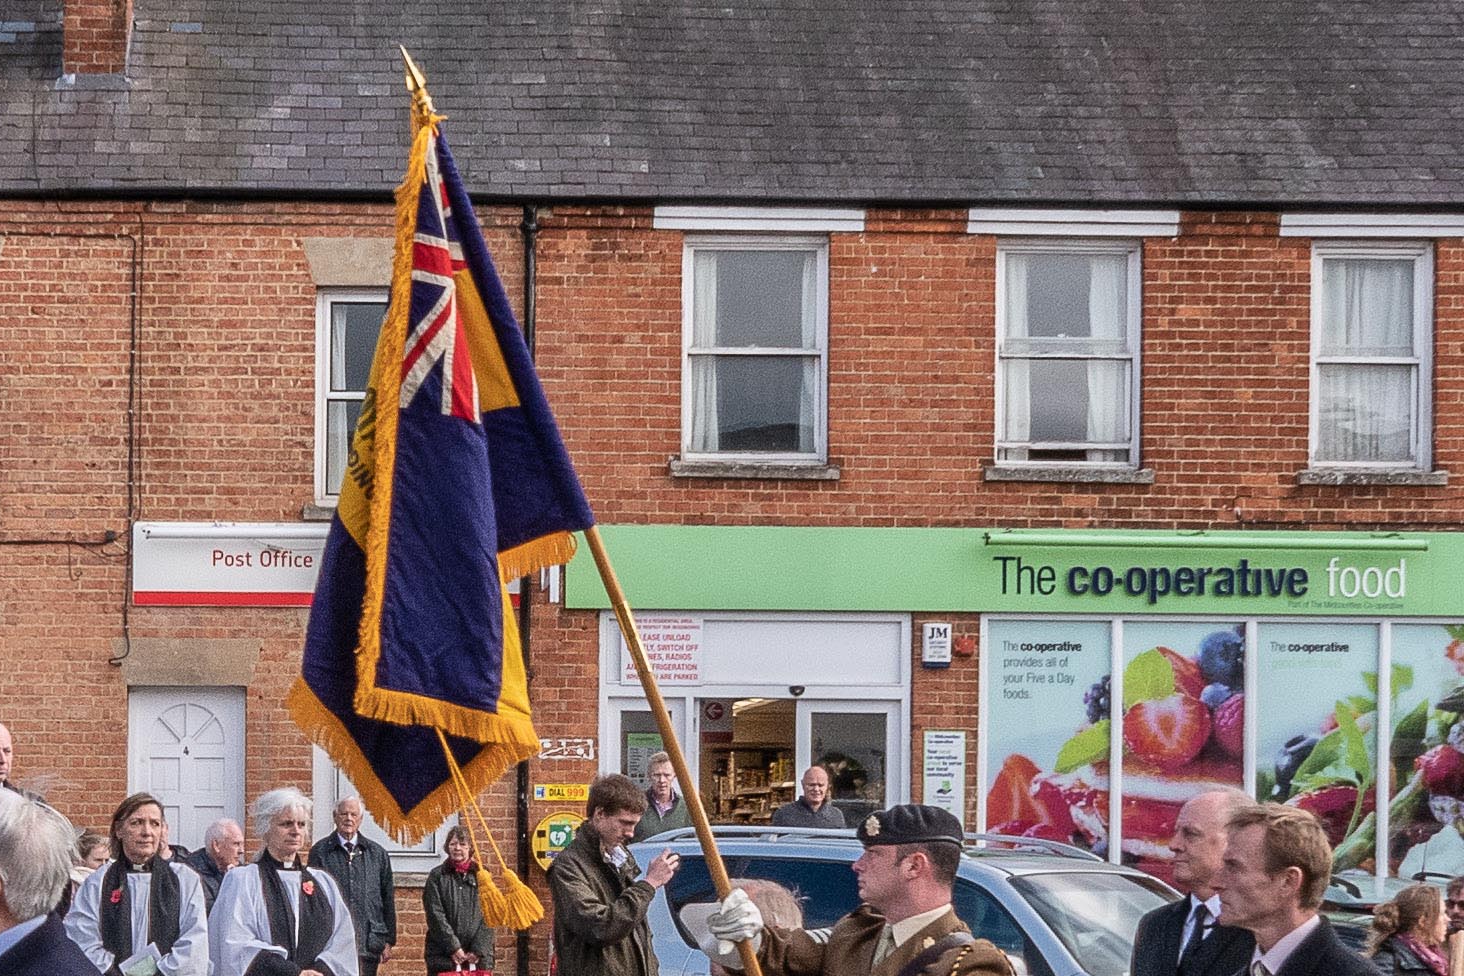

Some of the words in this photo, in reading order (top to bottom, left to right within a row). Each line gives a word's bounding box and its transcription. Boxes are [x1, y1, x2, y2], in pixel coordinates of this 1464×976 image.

[212, 550, 252, 567] Post
[259, 550, 313, 568] Office
[993, 556, 1056, 595] The
[1326, 557, 1406, 598] food
[929, 627, 948, 639] JM
[1003, 641, 1018, 651] The
[1020, 642, 1082, 653] co-operative
[1270, 641, 1286, 652] The
[1288, 642, 1349, 654] co-operative
[1003, 657, 1043, 668] provides
[1045, 657, 1057, 667] all
[1059, 656, 1069, 667] of
[1003, 674, 1023, 685] your
[1027, 672, 1045, 683] Five
[1048, 675, 1054, 683] a
[1057, 672, 1075, 686] Day
[549, 788, 565, 796] DIAL
[567, 788, 584, 796] 999
